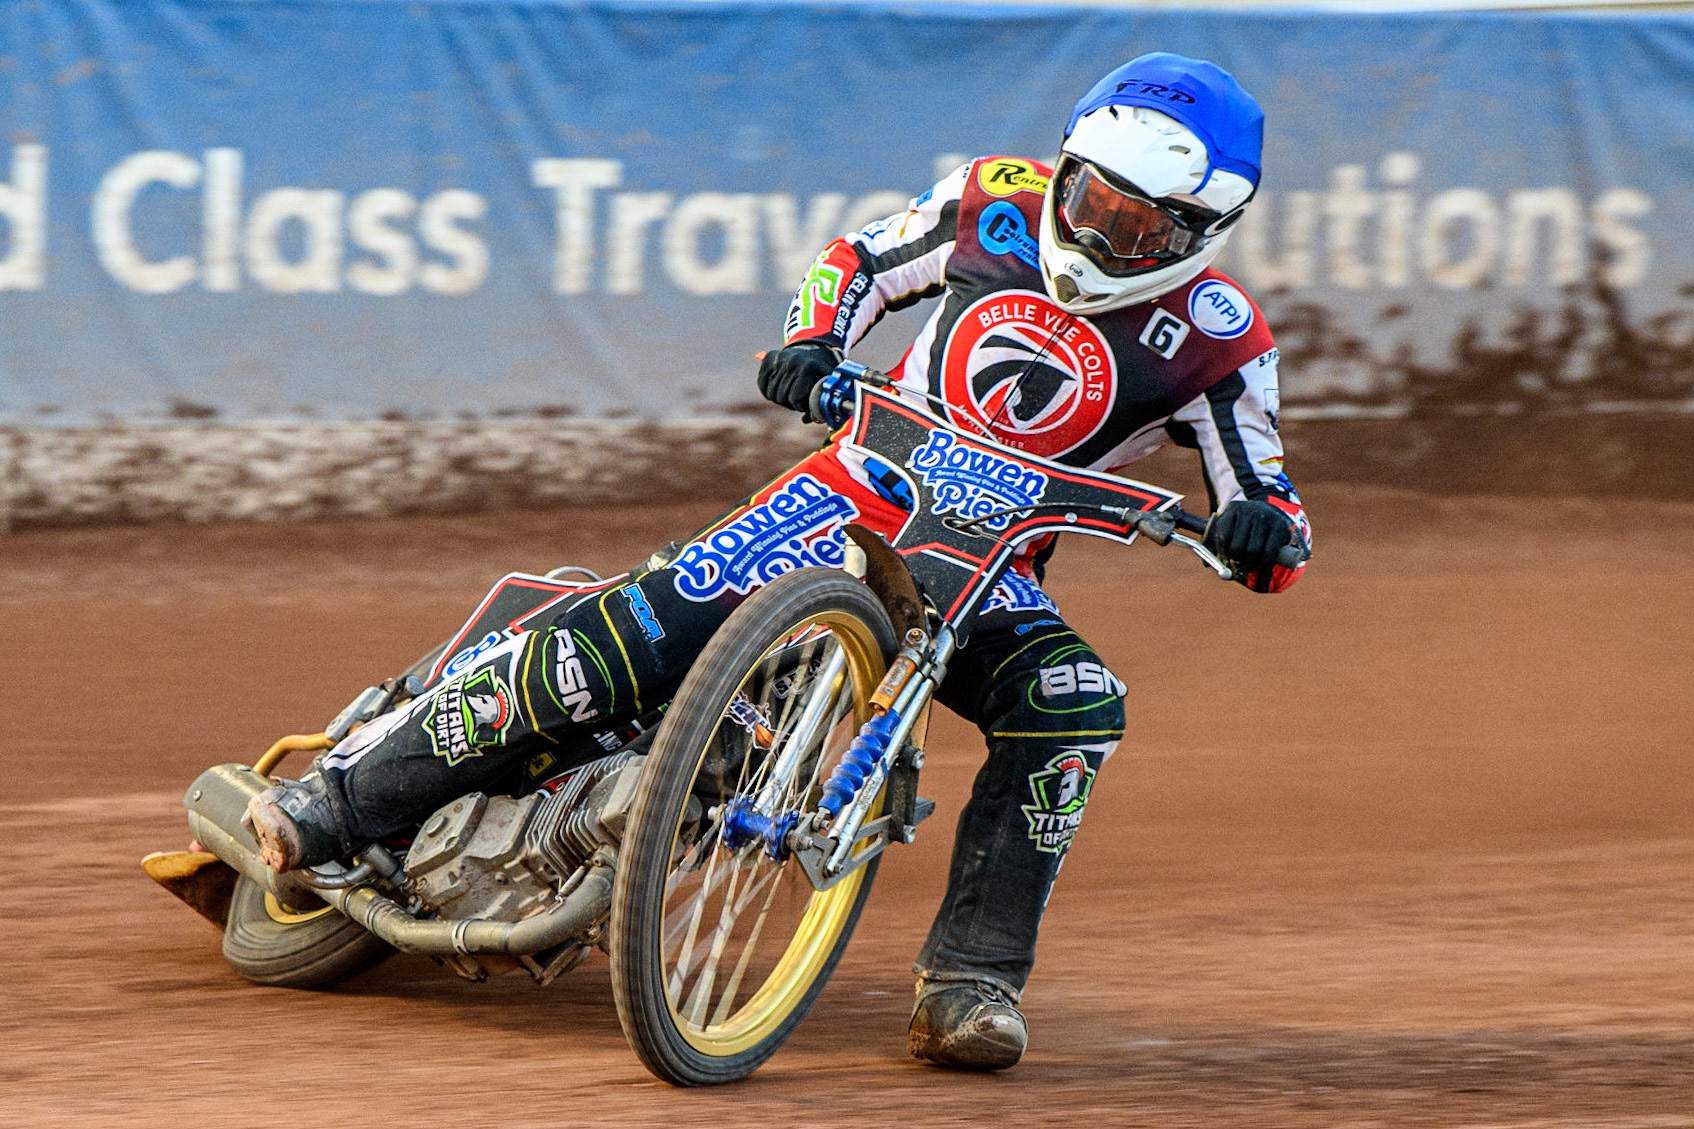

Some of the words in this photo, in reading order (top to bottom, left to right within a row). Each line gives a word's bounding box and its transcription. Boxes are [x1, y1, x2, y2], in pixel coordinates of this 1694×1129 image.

[93, 147, 490, 295] Class
[531, 153, 972, 295] Trav
[1237, 151, 1652, 289] utions
[1203, 291, 1241, 325] ATPI
[978, 303, 1038, 328] BELLE
[1044, 311, 1081, 342] VUE
[1077, 342, 1104, 402] COLTS
[1148, 315, 1181, 354] 6
[914, 430, 1045, 498] Bowen
[671, 475, 829, 597] Bowen
[1039, 662, 1127, 697] BSN
[438, 693, 448, 711] OF
[448, 677, 470, 758] TITANS
[437, 712, 449, 747] DIRT
[1043, 832, 1061, 845] OF
